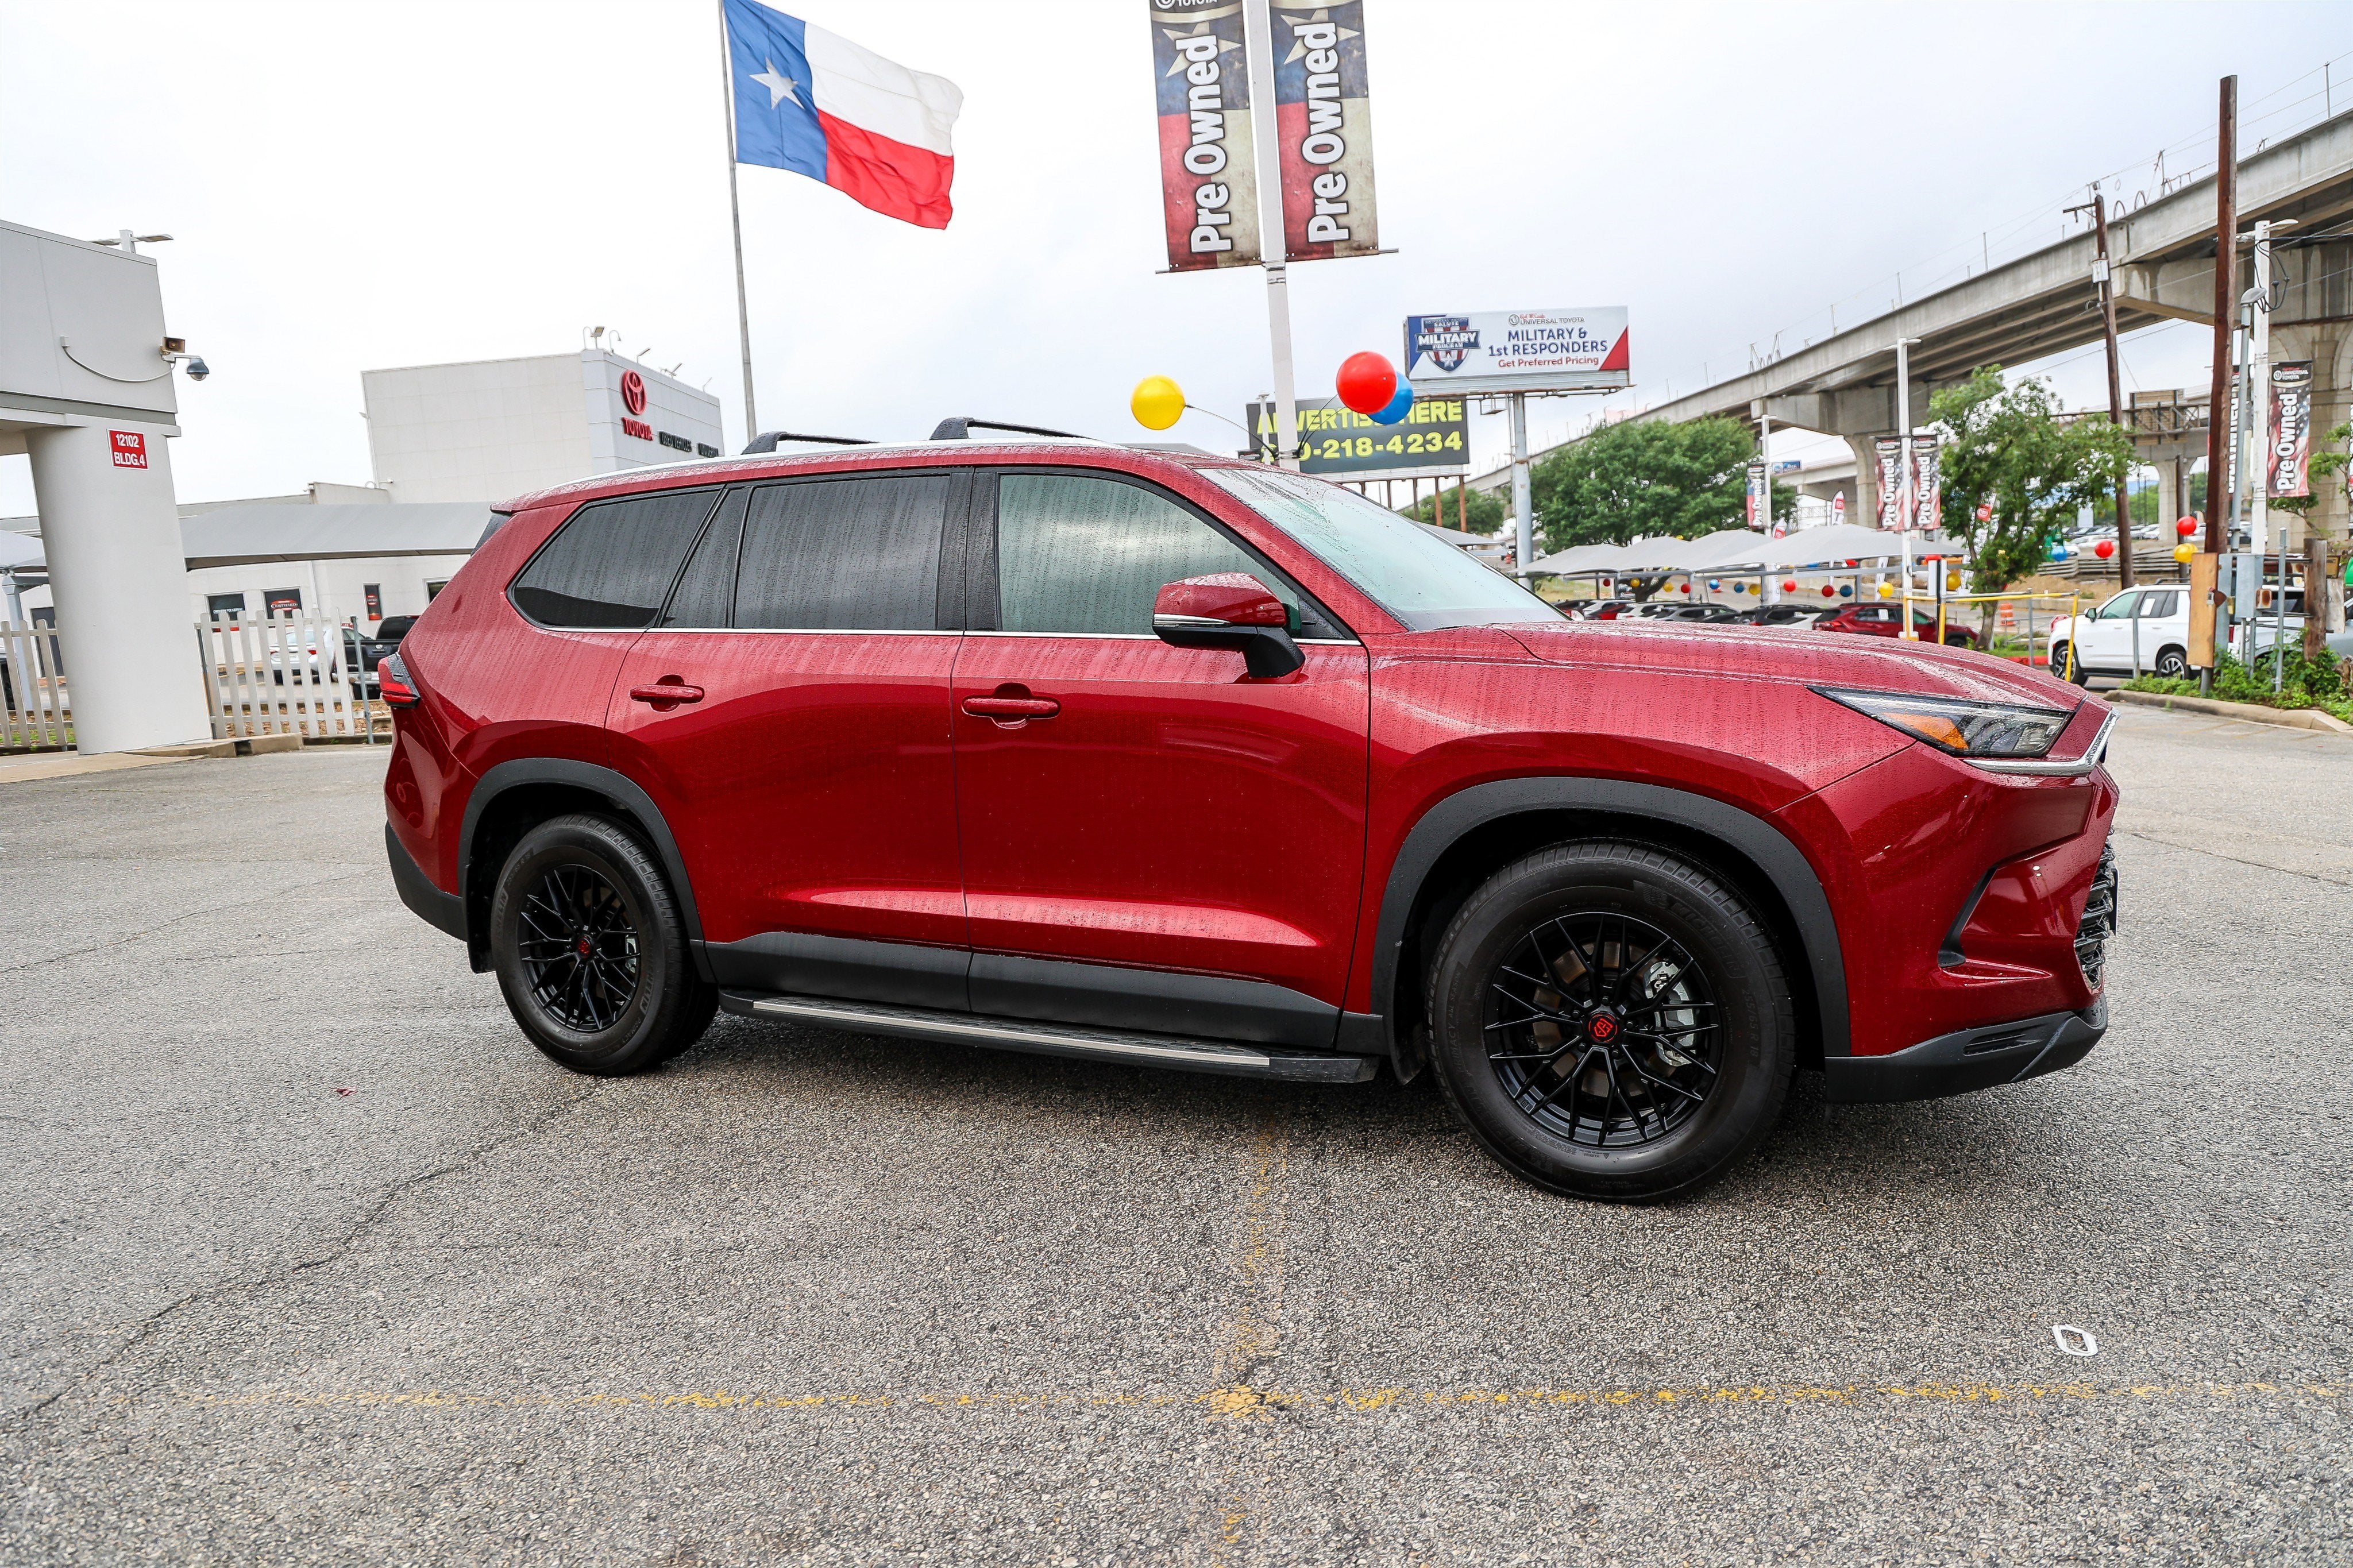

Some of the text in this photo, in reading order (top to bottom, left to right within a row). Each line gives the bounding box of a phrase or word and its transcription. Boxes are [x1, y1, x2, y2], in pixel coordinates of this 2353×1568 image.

[1175, 34, 1228, 176] Owned
[1293, 22, 1350, 243] Pre Owned
[1190, 183, 1233, 253] Pre
[1418, 332, 1477, 346] MILITARY
[1488, 339, 1608, 356] 1st RESPONDERS
[1508, 327, 1588, 342] MILITARY &
[1498, 356, 1599, 368] Get Preferred Pricing
[621, 416, 653, 441] TOYOTA
[1256, 404, 1388, 435] AVERTIS
[2276, 393, 2297, 457] Owned
[115, 434, 140, 448] 12102
[1881, 458, 1896, 503] Owned
[1916, 456, 1931, 502] Owned
[2277, 459, 2295, 491] Pre
[1752, 478, 1762, 510] Owned
[1752, 509, 1763, 526] Pre
[1882, 504, 1896, 527] Pre
[1917, 503, 1931, 525] Pre
